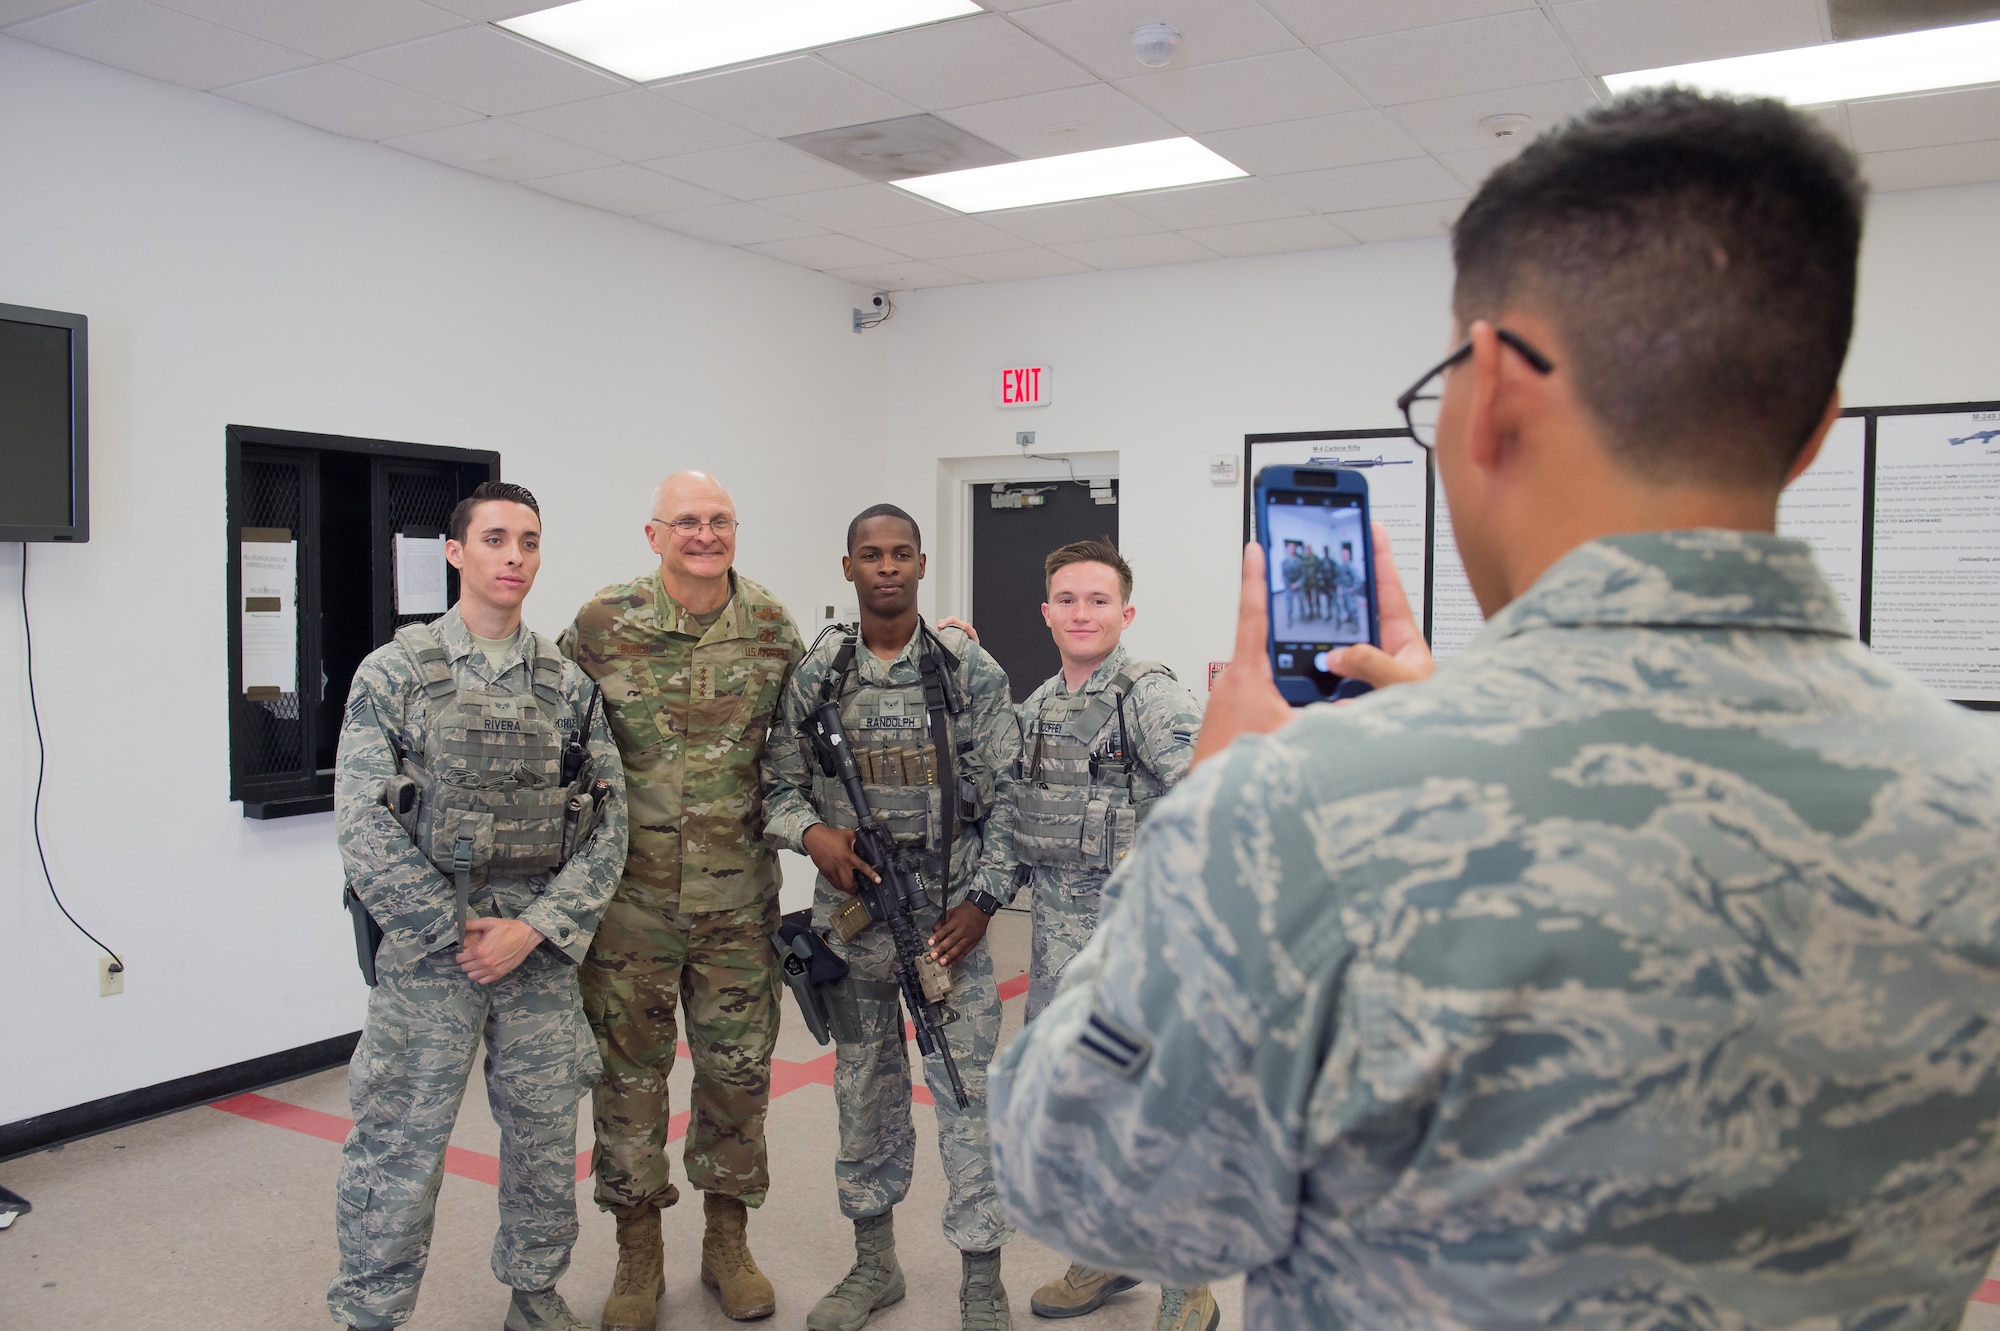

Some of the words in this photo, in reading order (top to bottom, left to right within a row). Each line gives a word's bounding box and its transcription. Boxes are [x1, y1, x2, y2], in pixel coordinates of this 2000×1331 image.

[1003, 368, 1041, 403] EXIT
[1210, 662, 1227, 671] FIRE
[484, 719, 521, 732] RIVERA
[866, 717, 915, 728] RANDOLPH
